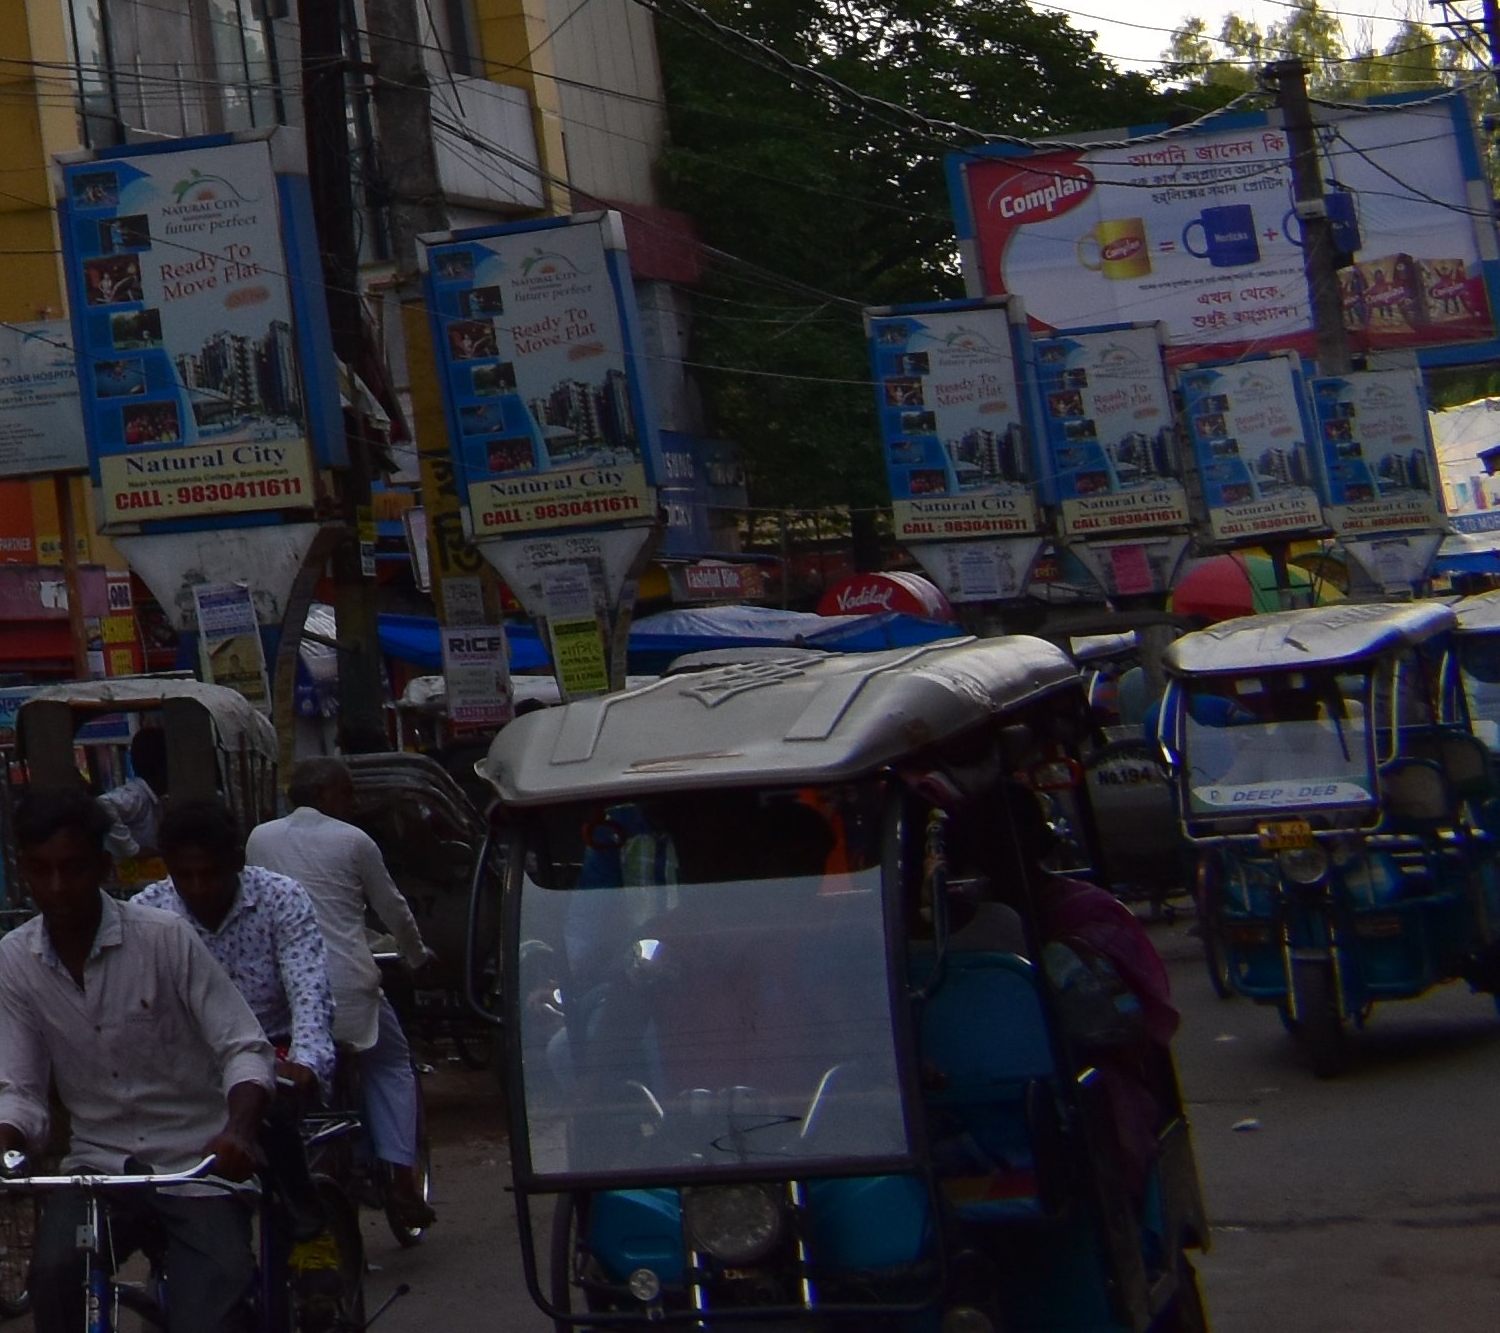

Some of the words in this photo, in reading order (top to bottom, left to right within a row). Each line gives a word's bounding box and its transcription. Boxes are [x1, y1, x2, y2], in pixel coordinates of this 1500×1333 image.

[1127, 145, 1187, 167] আপনি
[1196, 140, 1253, 161] জানেন
[1262, 133, 1284, 152] কি
[1000, 171, 1088, 218] Complan
[165, 218, 207, 235] future
[210, 214, 257, 233] perfect
[160, 253, 217, 281] Ready
[225, 244, 250, 261] To
[163, 275, 217, 301] Move
[225, 261, 260, 284] Flat
[1197, 290, 1232, 306] এখন
[512, 315, 561, 340] Ready
[565, 308, 588, 322] To
[515, 336, 562, 357] Move
[566, 322, 596, 339] Flat
[126, 450, 223, 475] Natural
[232, 445, 286, 467] City
[116, 489, 162, 510] CALL
[178, 477, 301, 504] 9830411611
[491, 476, 572, 496] Natural
[580, 471, 624, 487] City
[483, 509, 522, 526] CALL
[535, 496, 638, 518] 9830411611
[911, 497, 976, 513] Natural
[983, 497, 1016, 512] City
[1078, 496, 1136, 510] Natural
[1141, 493, 1171, 505] City
[904, 522, 934, 533] CALL
[944, 519, 1027, 532] 9830411611
[1072, 519, 1100, 529] CALL
[836, 582, 893, 612] Vadilal
[1232, 788, 1284, 802] DEEP
[1298, 784, 1338, 798] DEB
